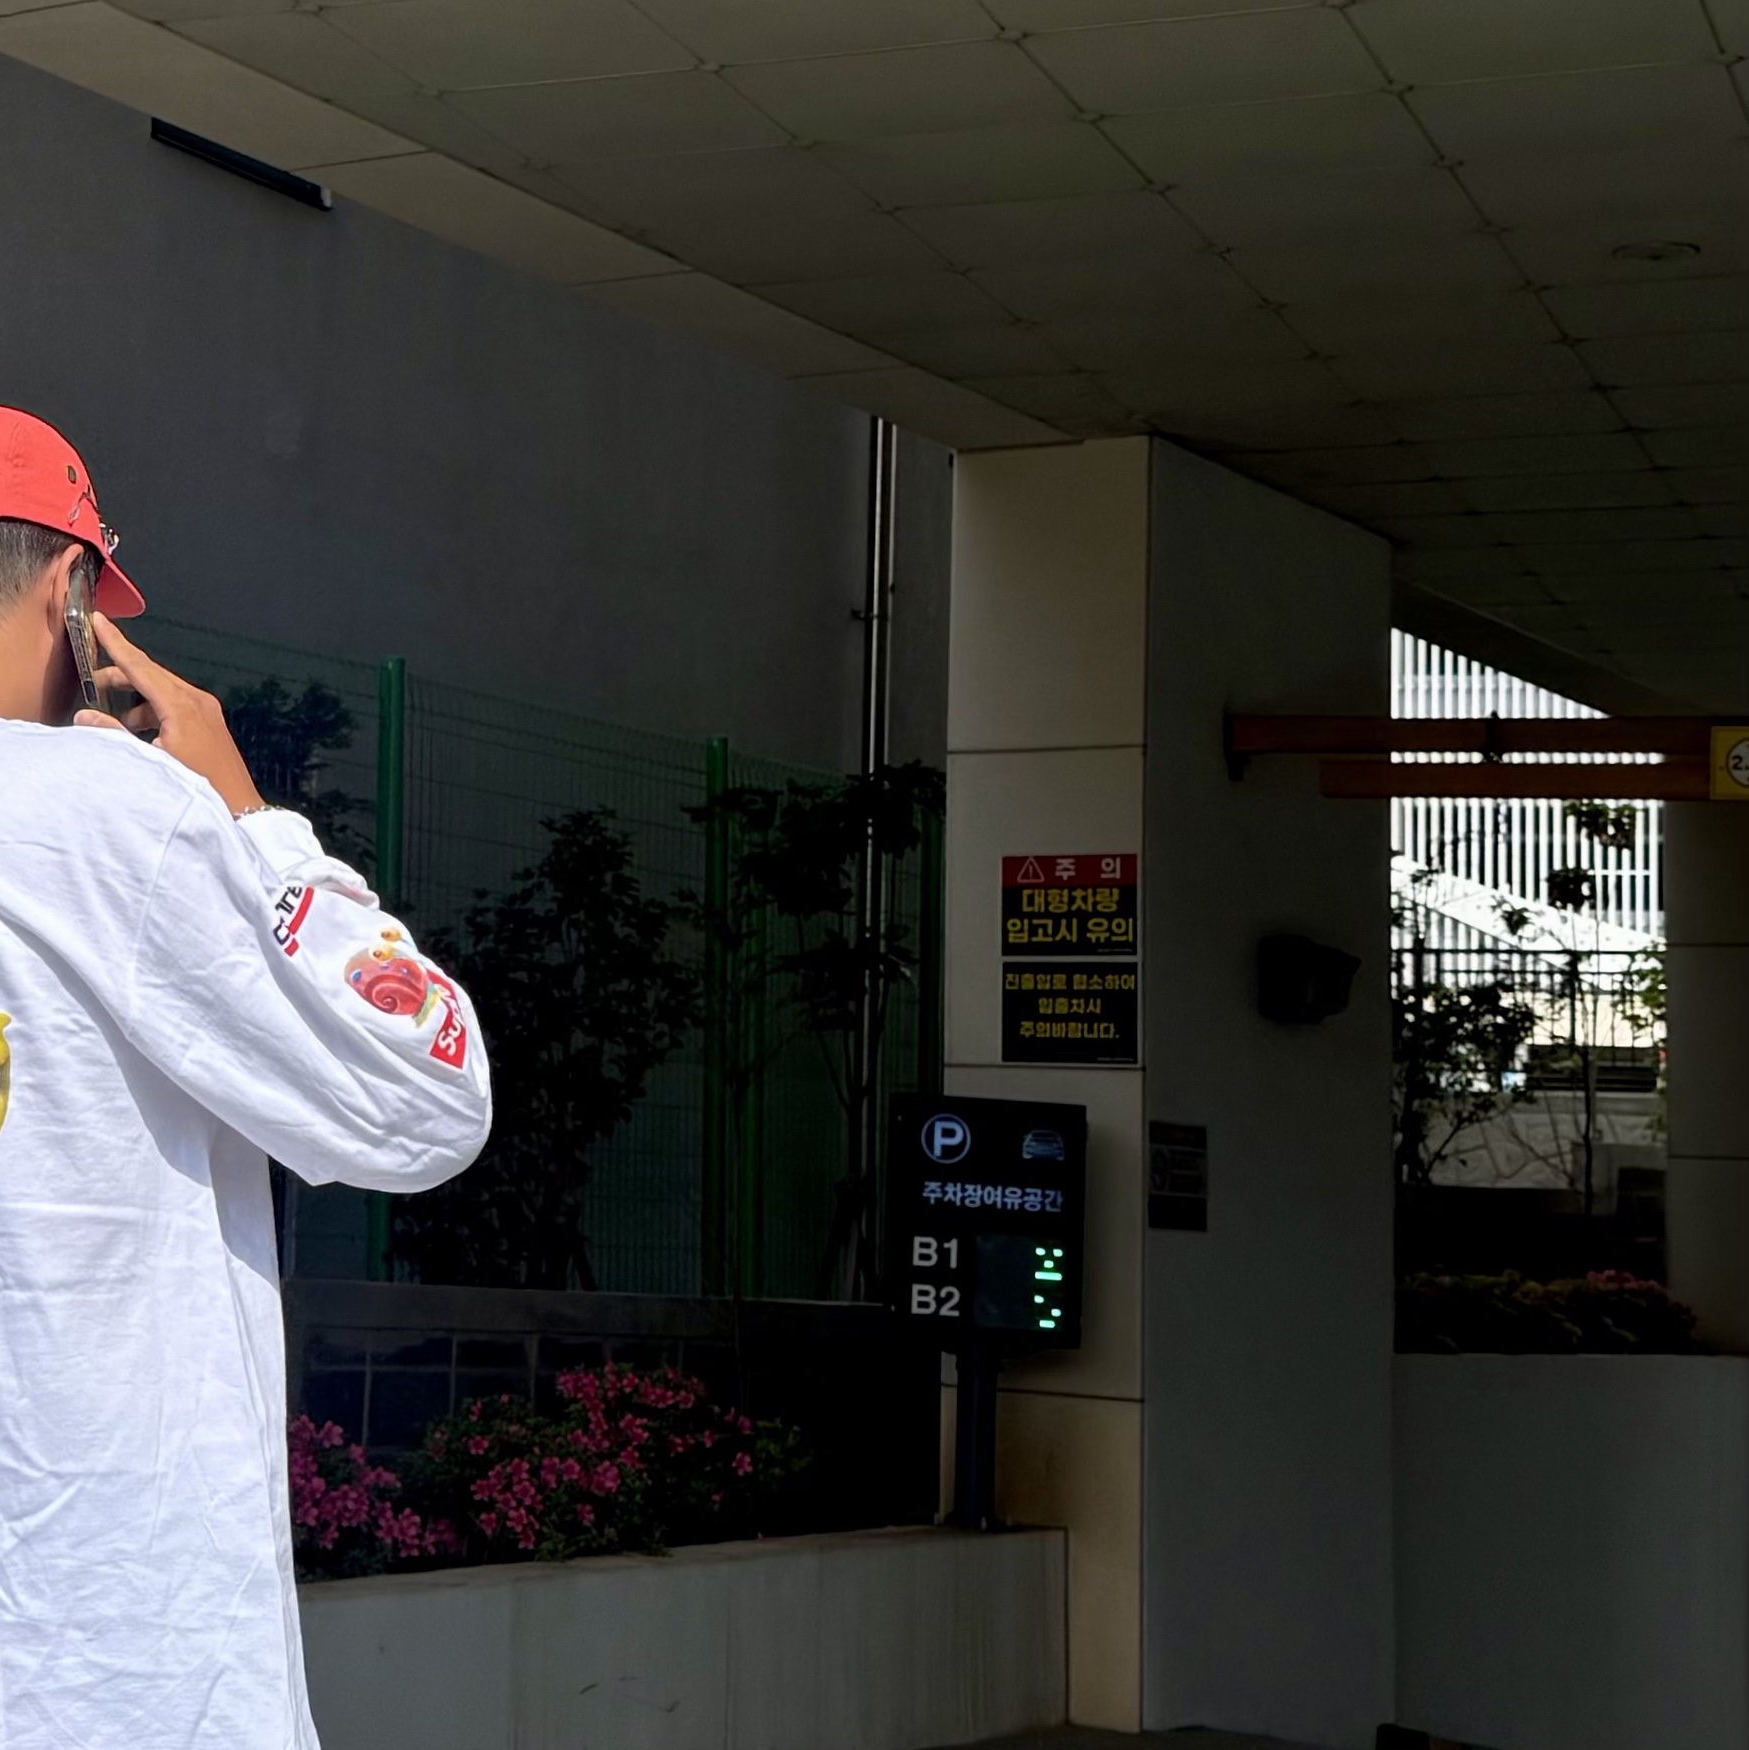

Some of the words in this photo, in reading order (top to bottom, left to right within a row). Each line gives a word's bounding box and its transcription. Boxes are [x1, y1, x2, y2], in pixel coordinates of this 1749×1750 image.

[1021, 887, 1121, 914] 대형차량
[1006, 917, 1079, 944] 입고시
[1086, 917, 1134, 944] 유의
[933, 1121, 964, 1157] P
[922, 1181, 1064, 1213] 주차장여유공간
[912, 1236, 958, 1269] B1
[911, 1283, 961, 1317] B2
